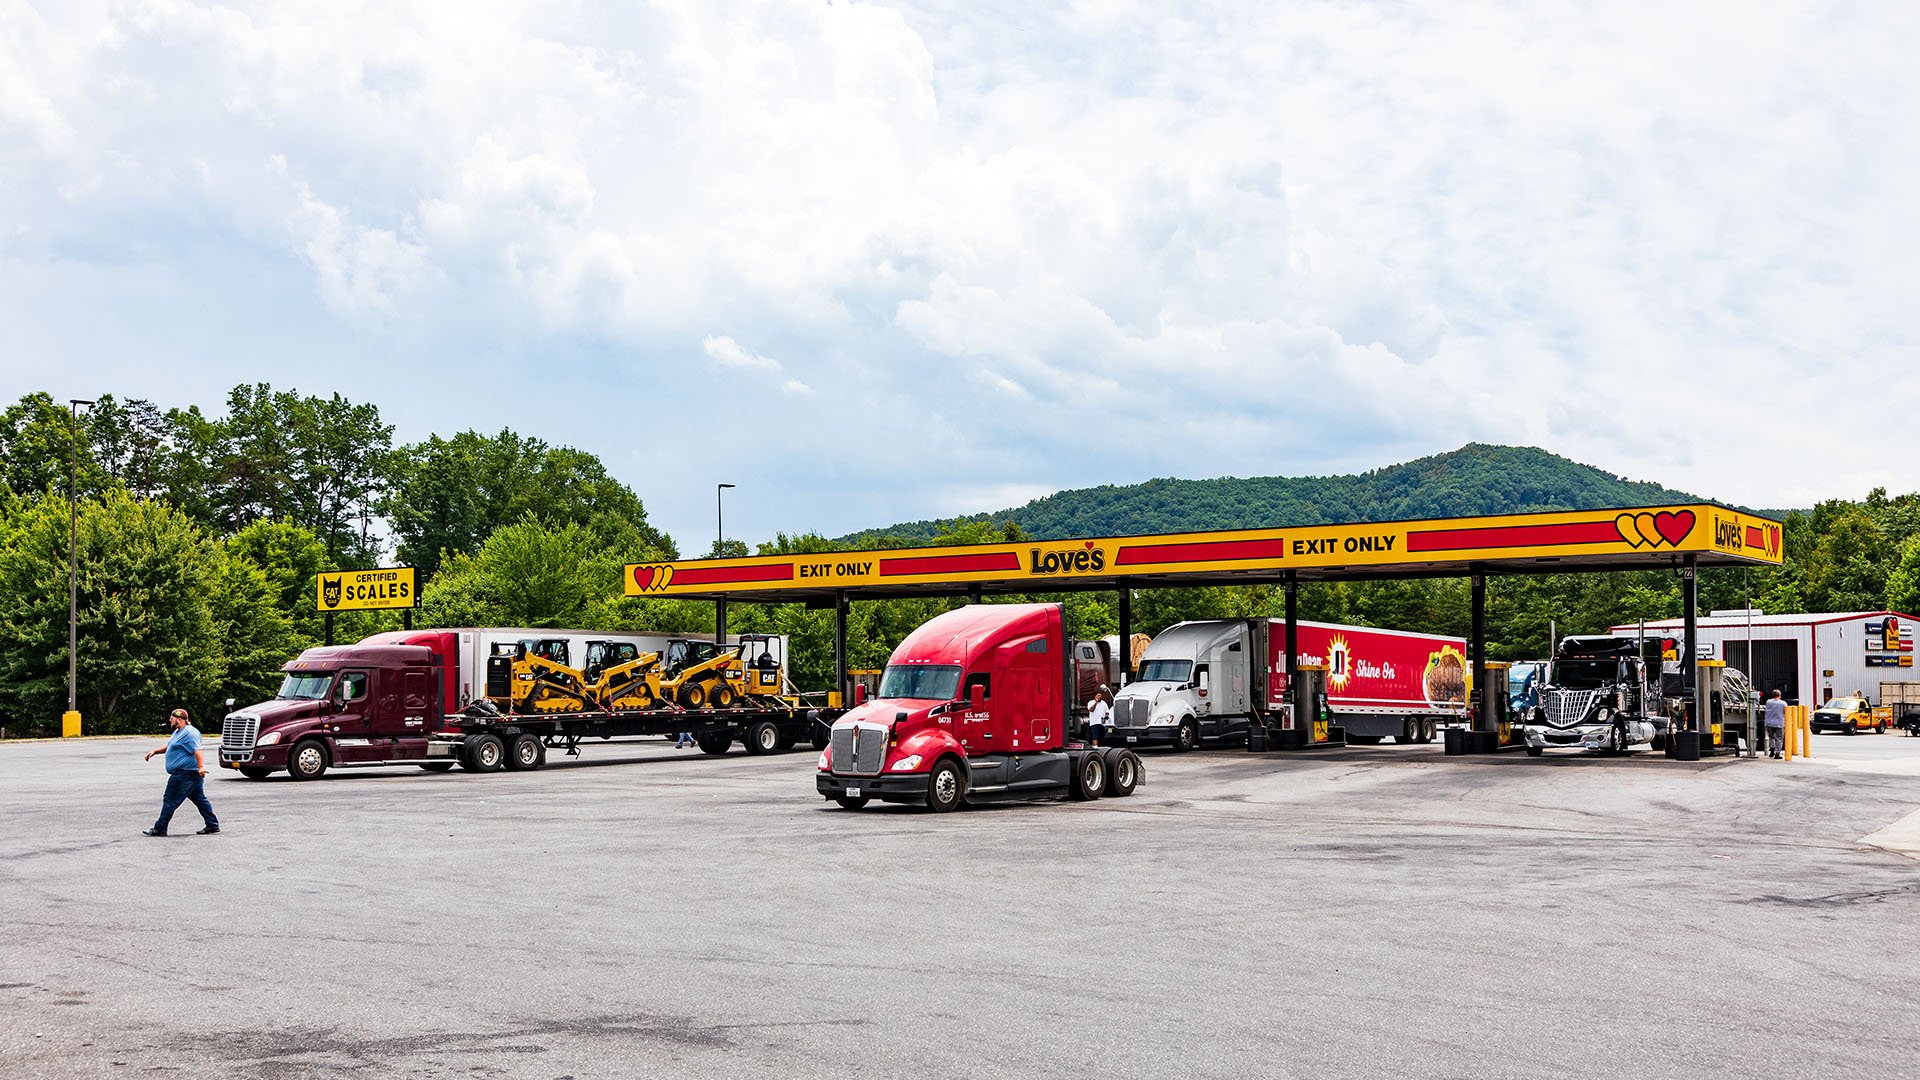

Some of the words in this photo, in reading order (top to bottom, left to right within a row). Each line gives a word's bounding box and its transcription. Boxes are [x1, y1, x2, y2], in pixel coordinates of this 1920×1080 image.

[1293, 539, 1338, 555] EXIT
[1344, 536, 1396, 552] ONLY
[800, 564, 832, 577] EXIT
[836, 562, 872, 576] ONLY
[356, 572, 397, 583] CERTIFIED
[325, 587, 339, 599] CAT
[346, 582, 409, 600] SCALES
[1356, 659, 1381, 678] Shine
[1382, 661, 1396, 679] On
[763, 674, 775, 682] CAT
